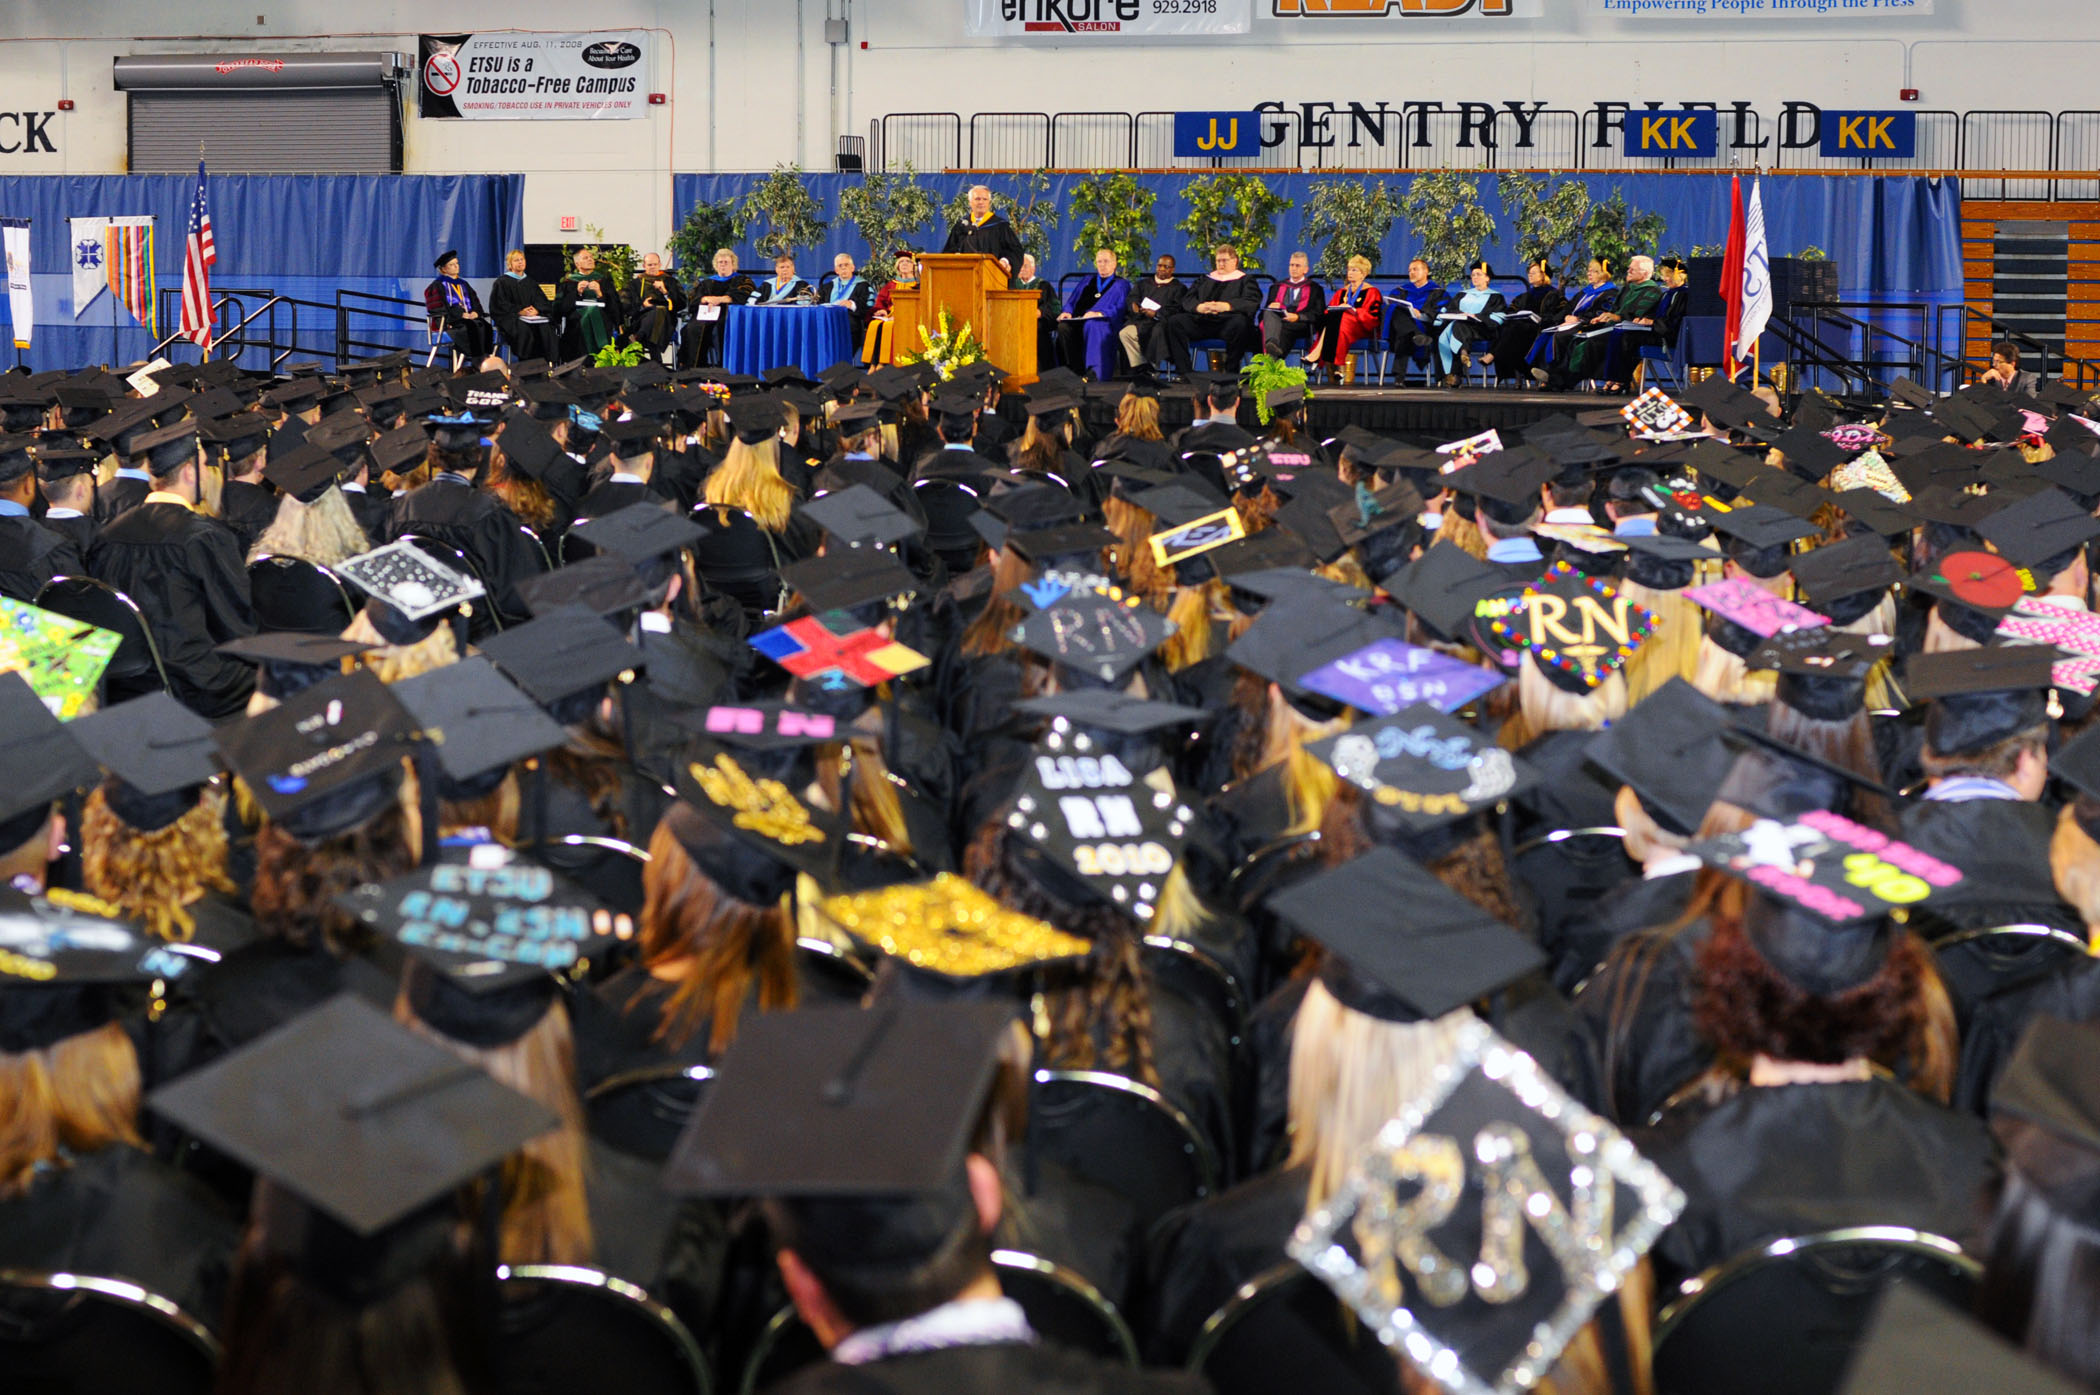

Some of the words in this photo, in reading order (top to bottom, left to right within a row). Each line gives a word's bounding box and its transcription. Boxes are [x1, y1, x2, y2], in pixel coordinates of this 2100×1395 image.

[1153, 0, 1217, 14] 929.2918
[1711, 0, 1765, 13] People
[1077, 22, 1117, 31] SALON
[474, 41, 518, 49] EFFECTIVE
[469, 57, 504, 73] ETSU
[507, 57, 520, 72] is
[525, 58, 534, 72] a
[466, 76, 571, 95] Tobacco-Free
[576, 76, 636, 95] Campus
[614, 101, 631, 109] ONLY
[1197, 117, 1238, 150] JJ
[1252, 101, 1548, 148] GENTRY
[1592, 101, 1821, 148] FLD
[1641, 116, 1697, 149] KK
[1838, 116, 1896, 149] KK
[1051, 607, 1146, 653] RN
[1520, 594, 1630, 645] RN
[1073, 842, 1173, 876] 2010
[1352, 1120, 1617, 1307] RN
